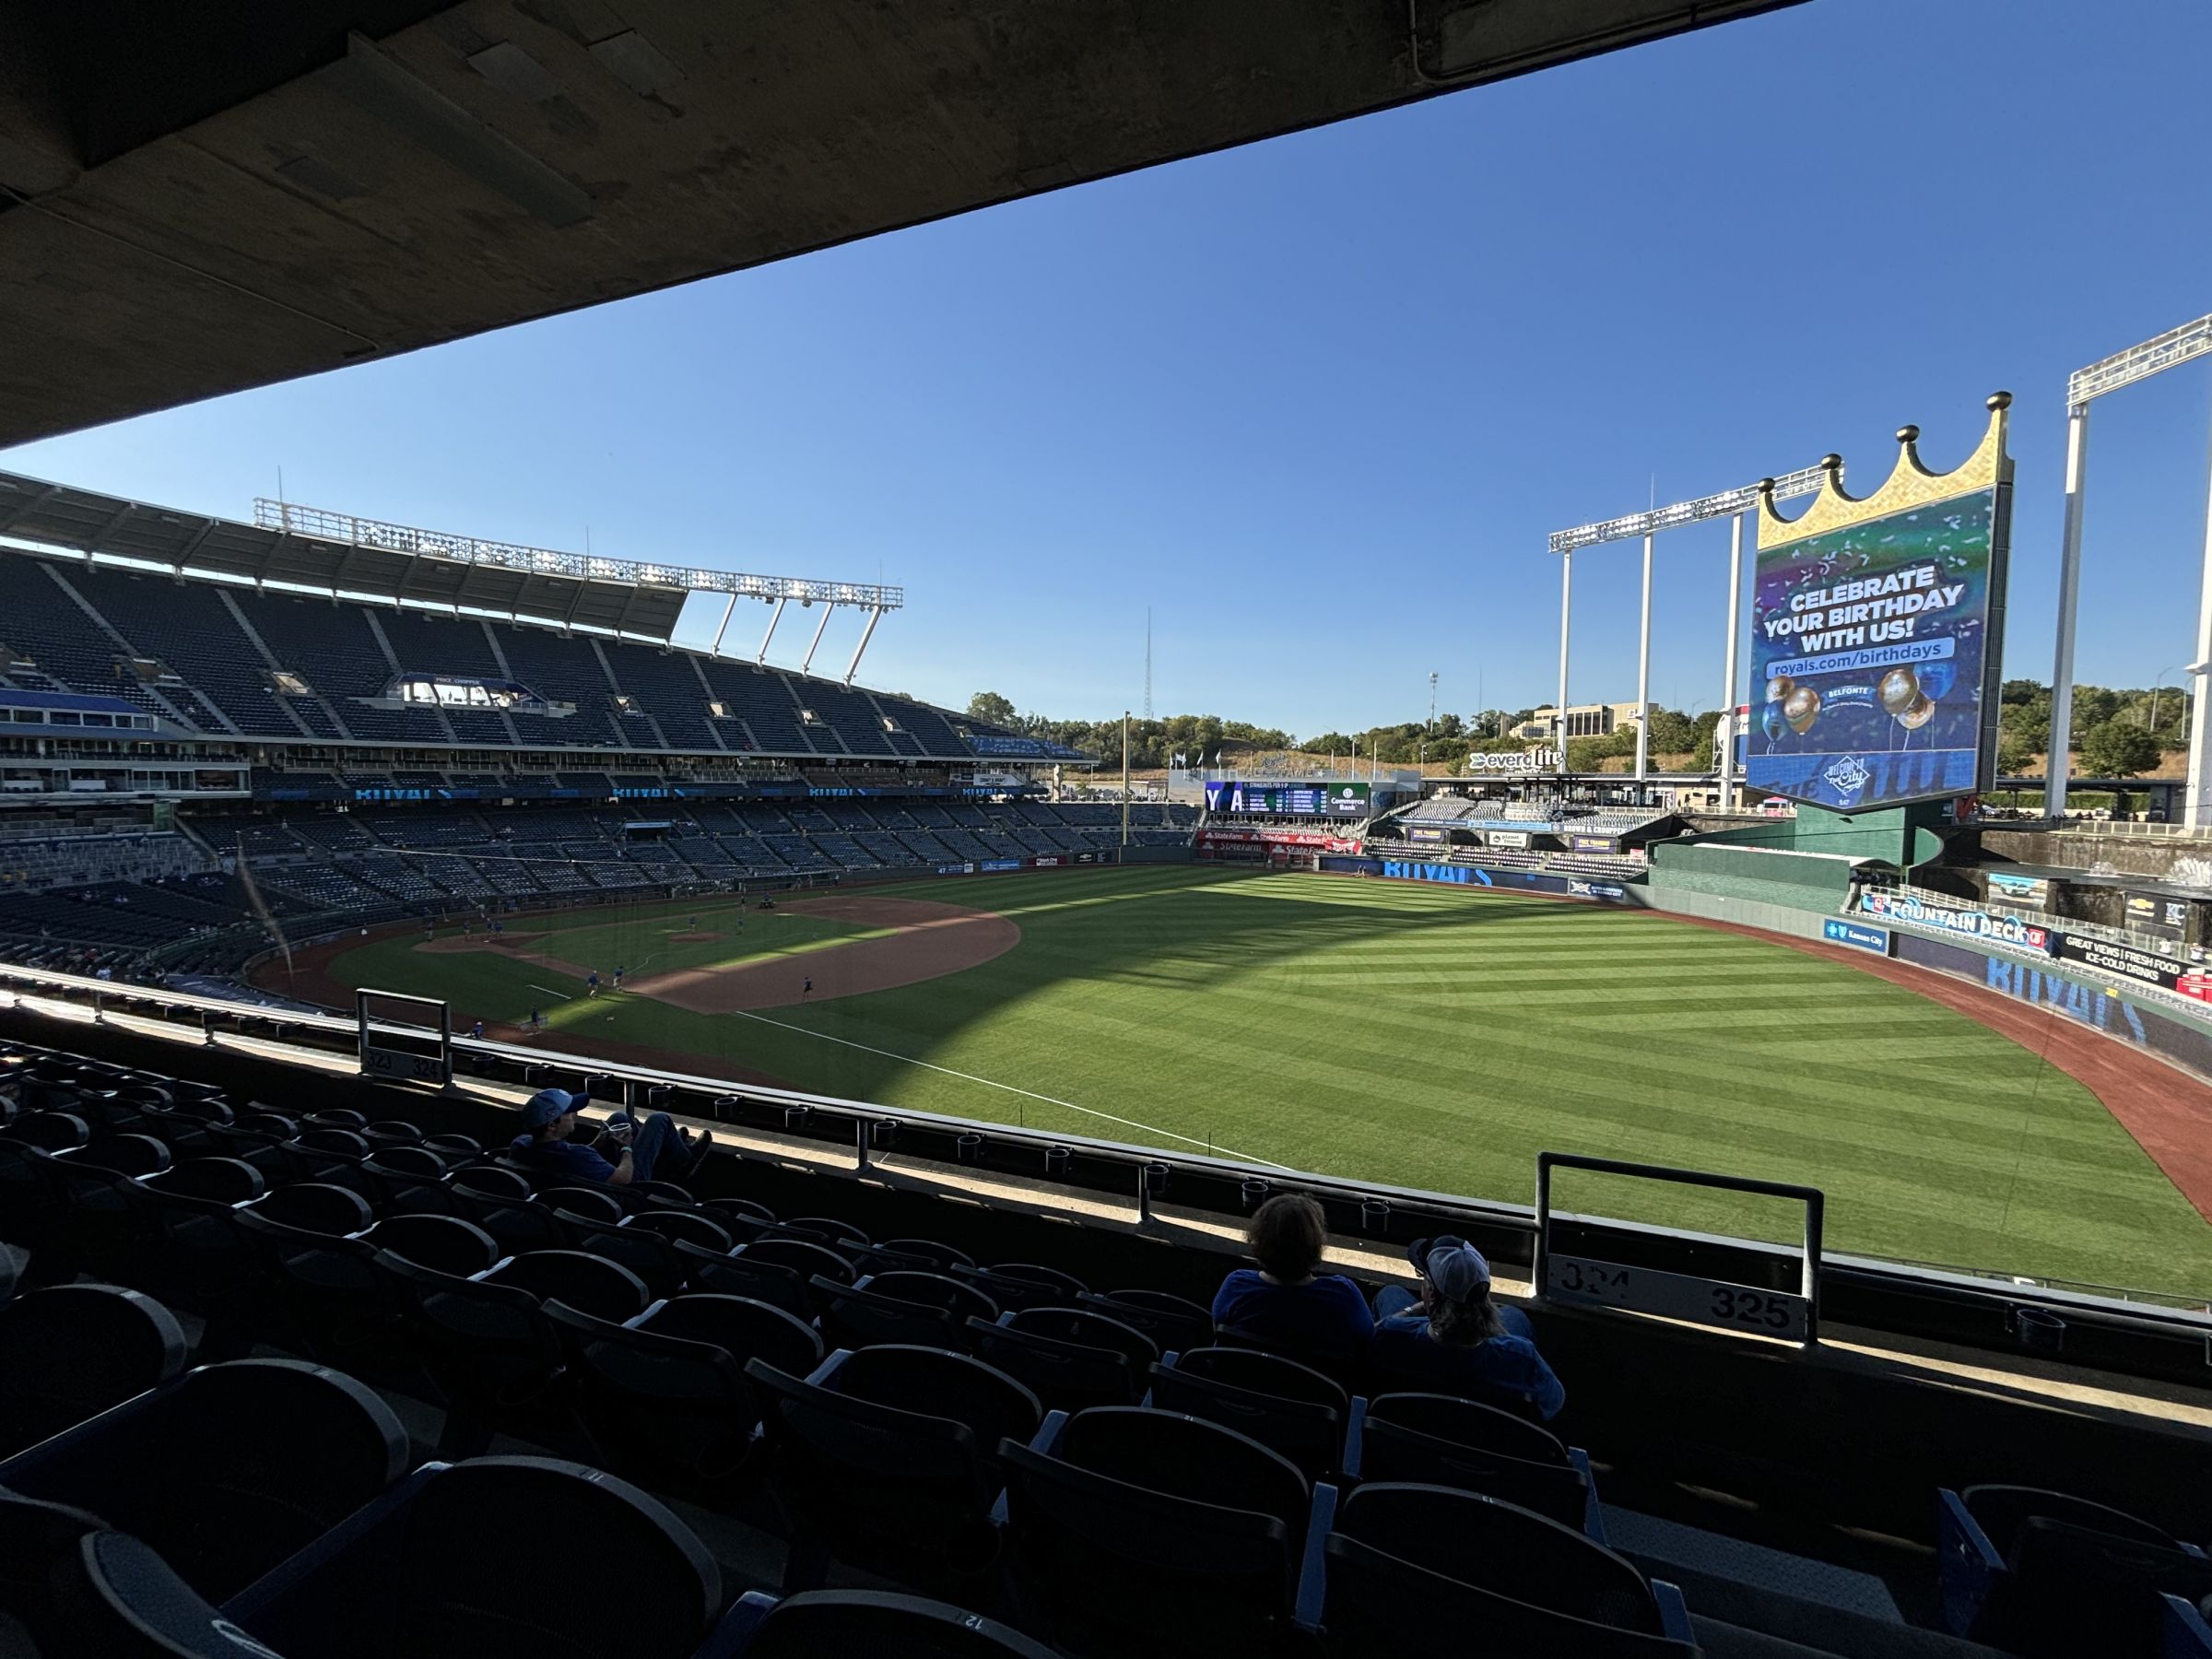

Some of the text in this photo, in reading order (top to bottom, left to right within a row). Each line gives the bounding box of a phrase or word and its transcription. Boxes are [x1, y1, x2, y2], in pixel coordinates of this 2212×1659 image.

[1791, 565, 1935, 612] CELEBRATE
[1764, 584, 1964, 638] YOUR BIRTHDAY
[1801, 618, 1914, 653] WITH US!
[1775, 643, 1941, 675] royals.com/birthdays
[1829, 688, 1867, 698] BELFONTE
[1206, 790, 1219, 811] Y
[1230, 790, 1242, 811] A
[1849, 930, 1882, 947] Kansas City
[1890, 902, 1977, 931] FOUNTAIN
[1980, 918, 2027, 943] DECK
[2065, 936, 2181, 974] GREAT VIEWS FRESH FOOD
[2085, 952, 2159, 981] ICE-COLD DRINKS
[1711, 1287, 1790, 1328] 325
[966, 1615, 982, 1630] 12
